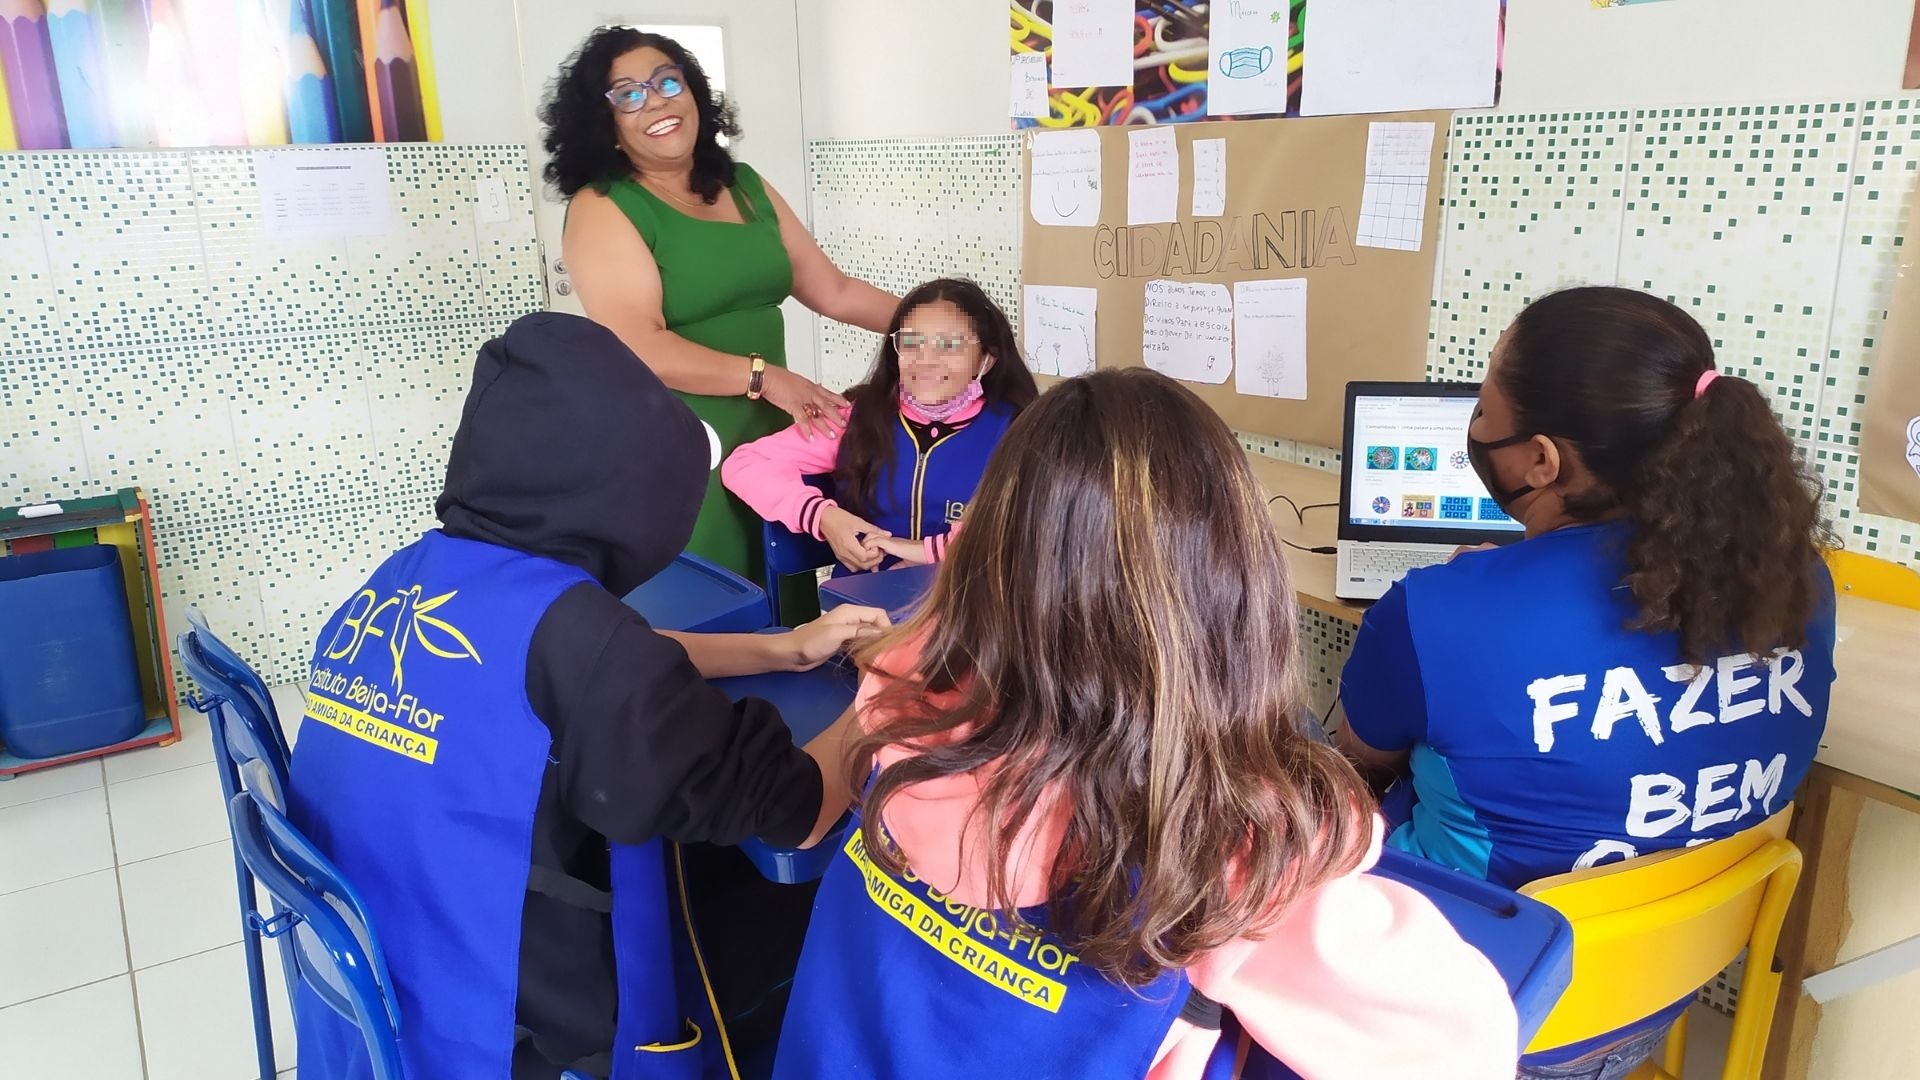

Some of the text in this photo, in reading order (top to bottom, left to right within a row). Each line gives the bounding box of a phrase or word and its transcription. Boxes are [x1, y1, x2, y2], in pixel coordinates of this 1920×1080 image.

[1093, 206, 1357, 279] CIDADANIA
[311, 701, 338, 722] AMIGA
[340, 711, 353, 728] DA
[356, 719, 427, 756] CRIANÇA
[345, 675, 444, 733] Beija-Flor
[1526, 646, 1813, 753] FAZER
[1625, 753, 1787, 838] BEM
[867, 869, 915, 921] AMIGA
[918, 914, 943, 943] DA
[949, 937, 1049, 1003] CRIANÇA
